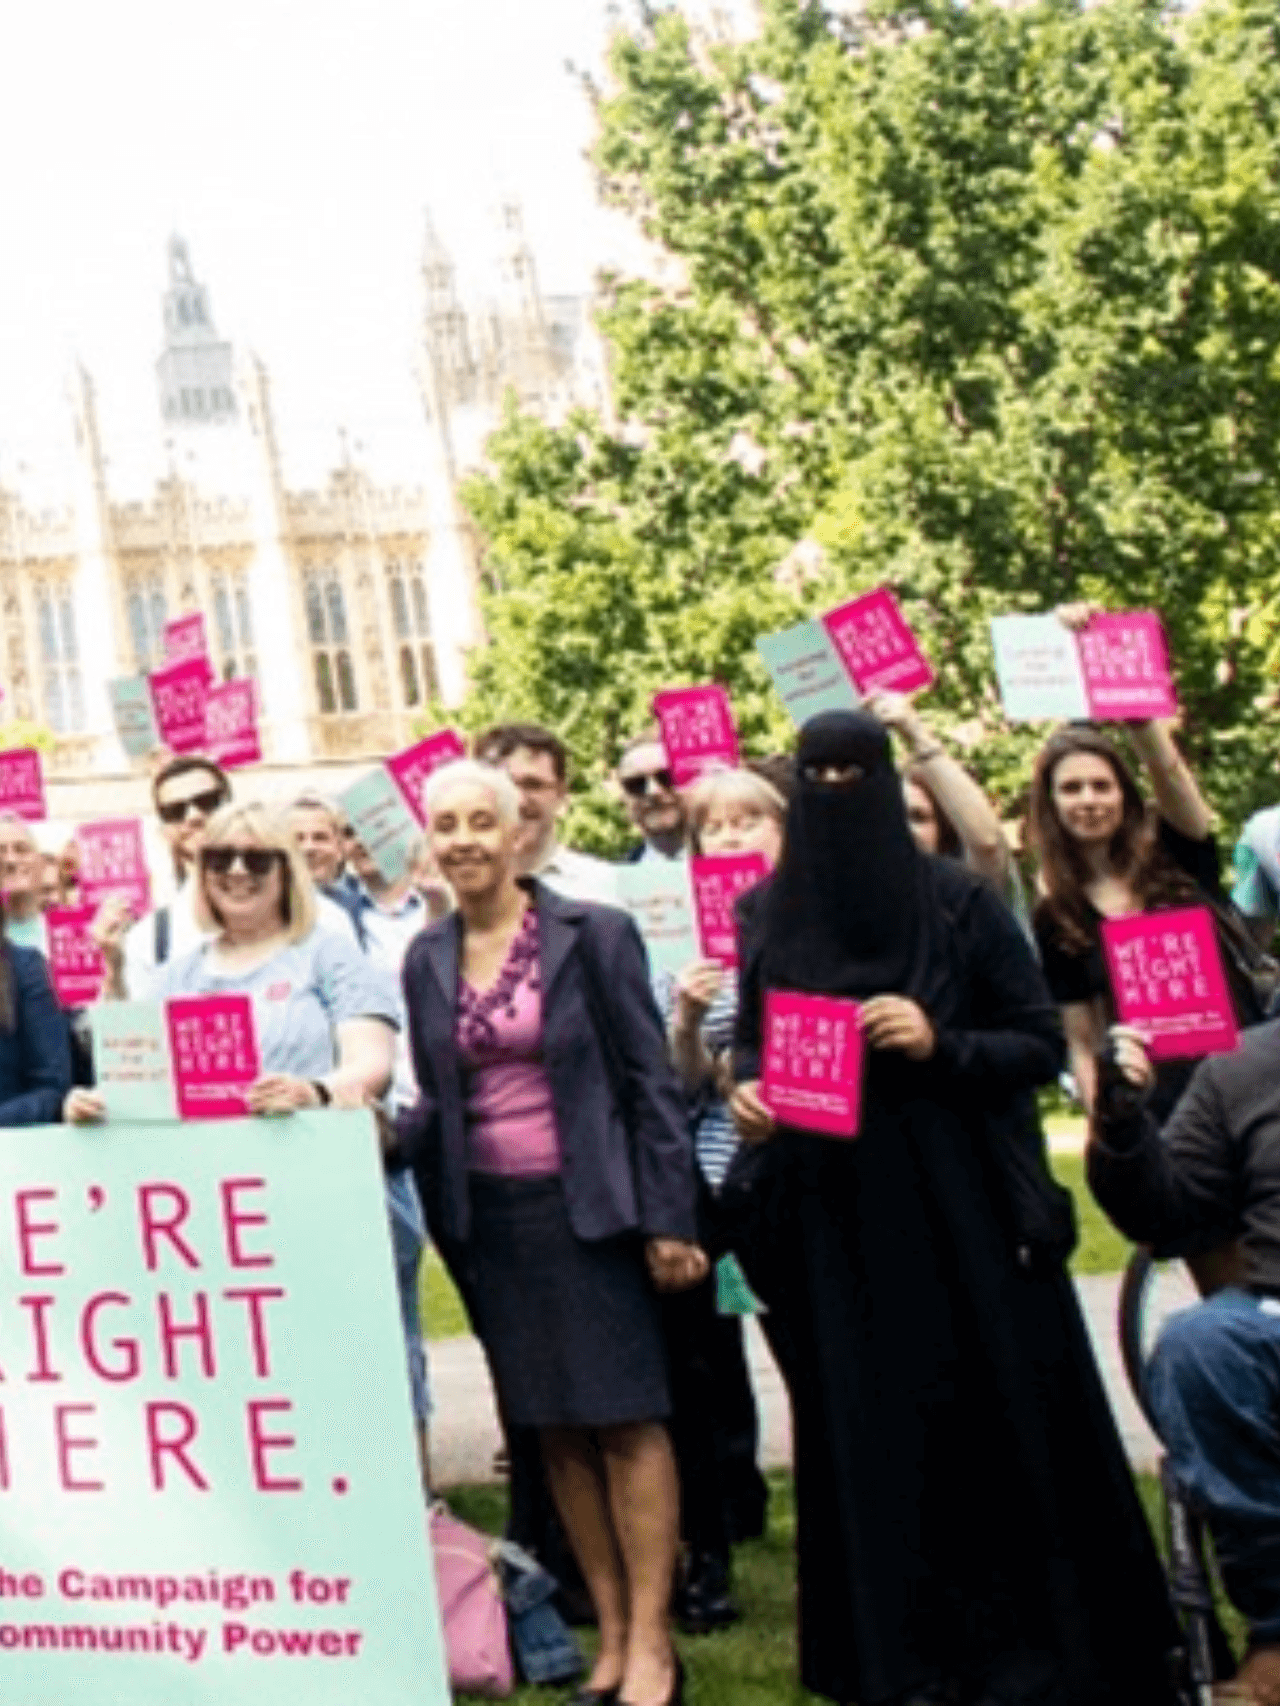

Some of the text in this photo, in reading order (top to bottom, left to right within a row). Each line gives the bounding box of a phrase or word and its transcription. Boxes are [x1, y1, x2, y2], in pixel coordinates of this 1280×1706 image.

[1115, 931, 1196, 959] WE'RE
[57, 1567, 276, 1611] Campaign
[287, 1570, 350, 1604] for
[221, 1620, 362, 1656] Power
